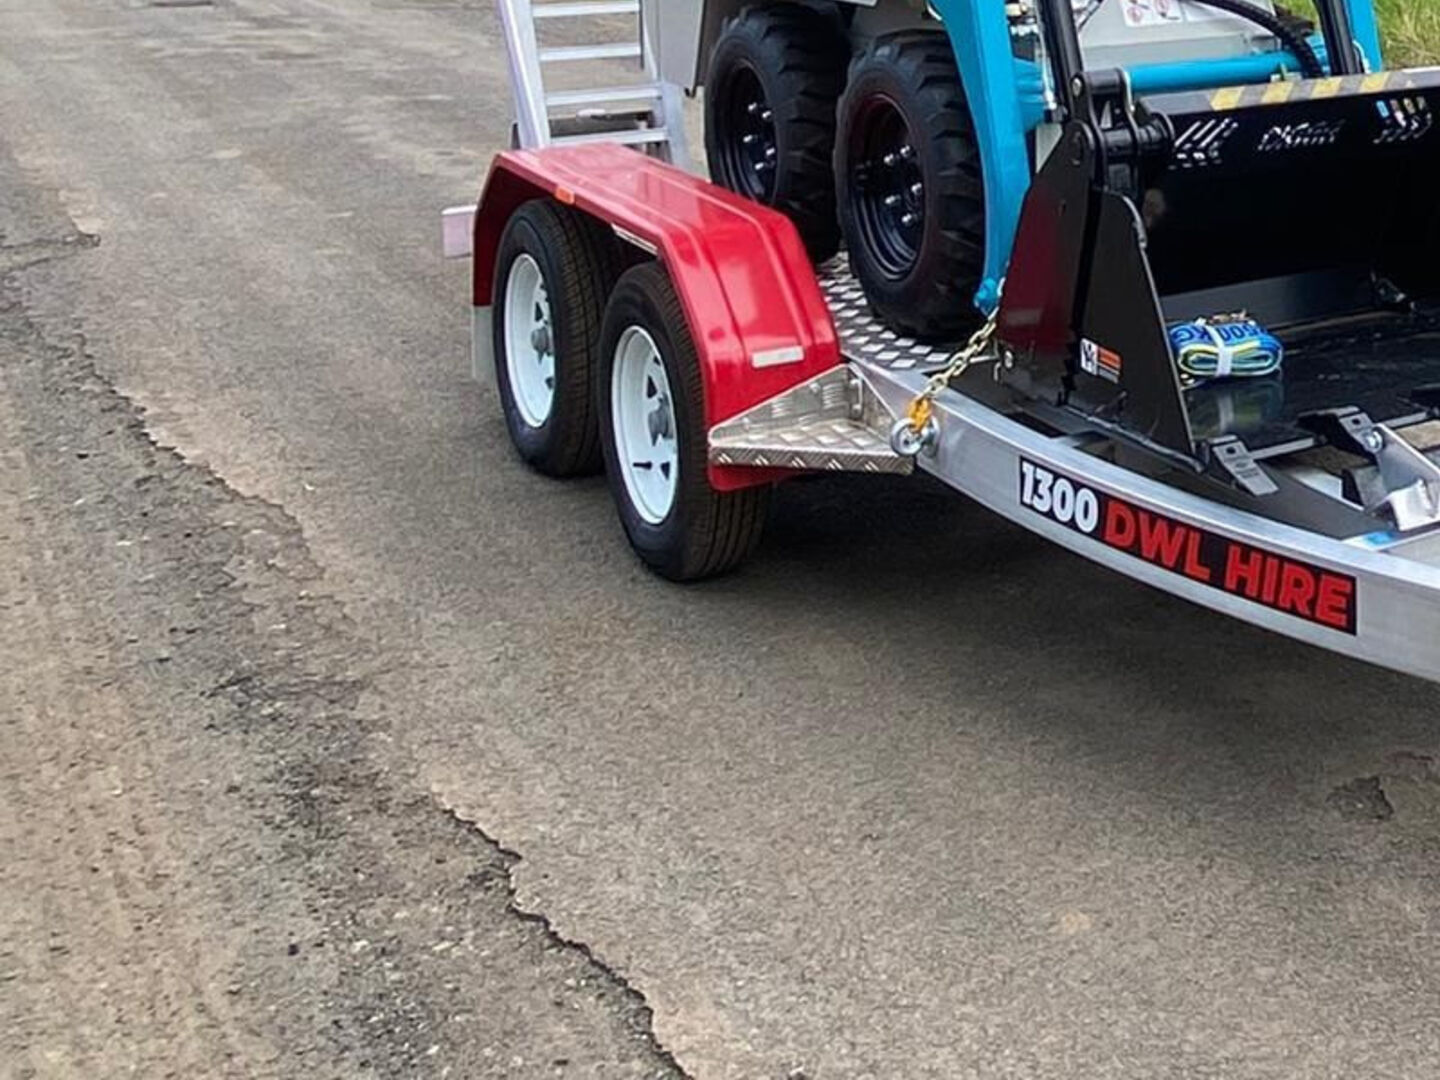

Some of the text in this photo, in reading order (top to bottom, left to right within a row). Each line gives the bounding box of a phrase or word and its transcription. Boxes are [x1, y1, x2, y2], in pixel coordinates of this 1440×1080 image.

[1019, 461, 1354, 630] 1300 DWL HIRE
